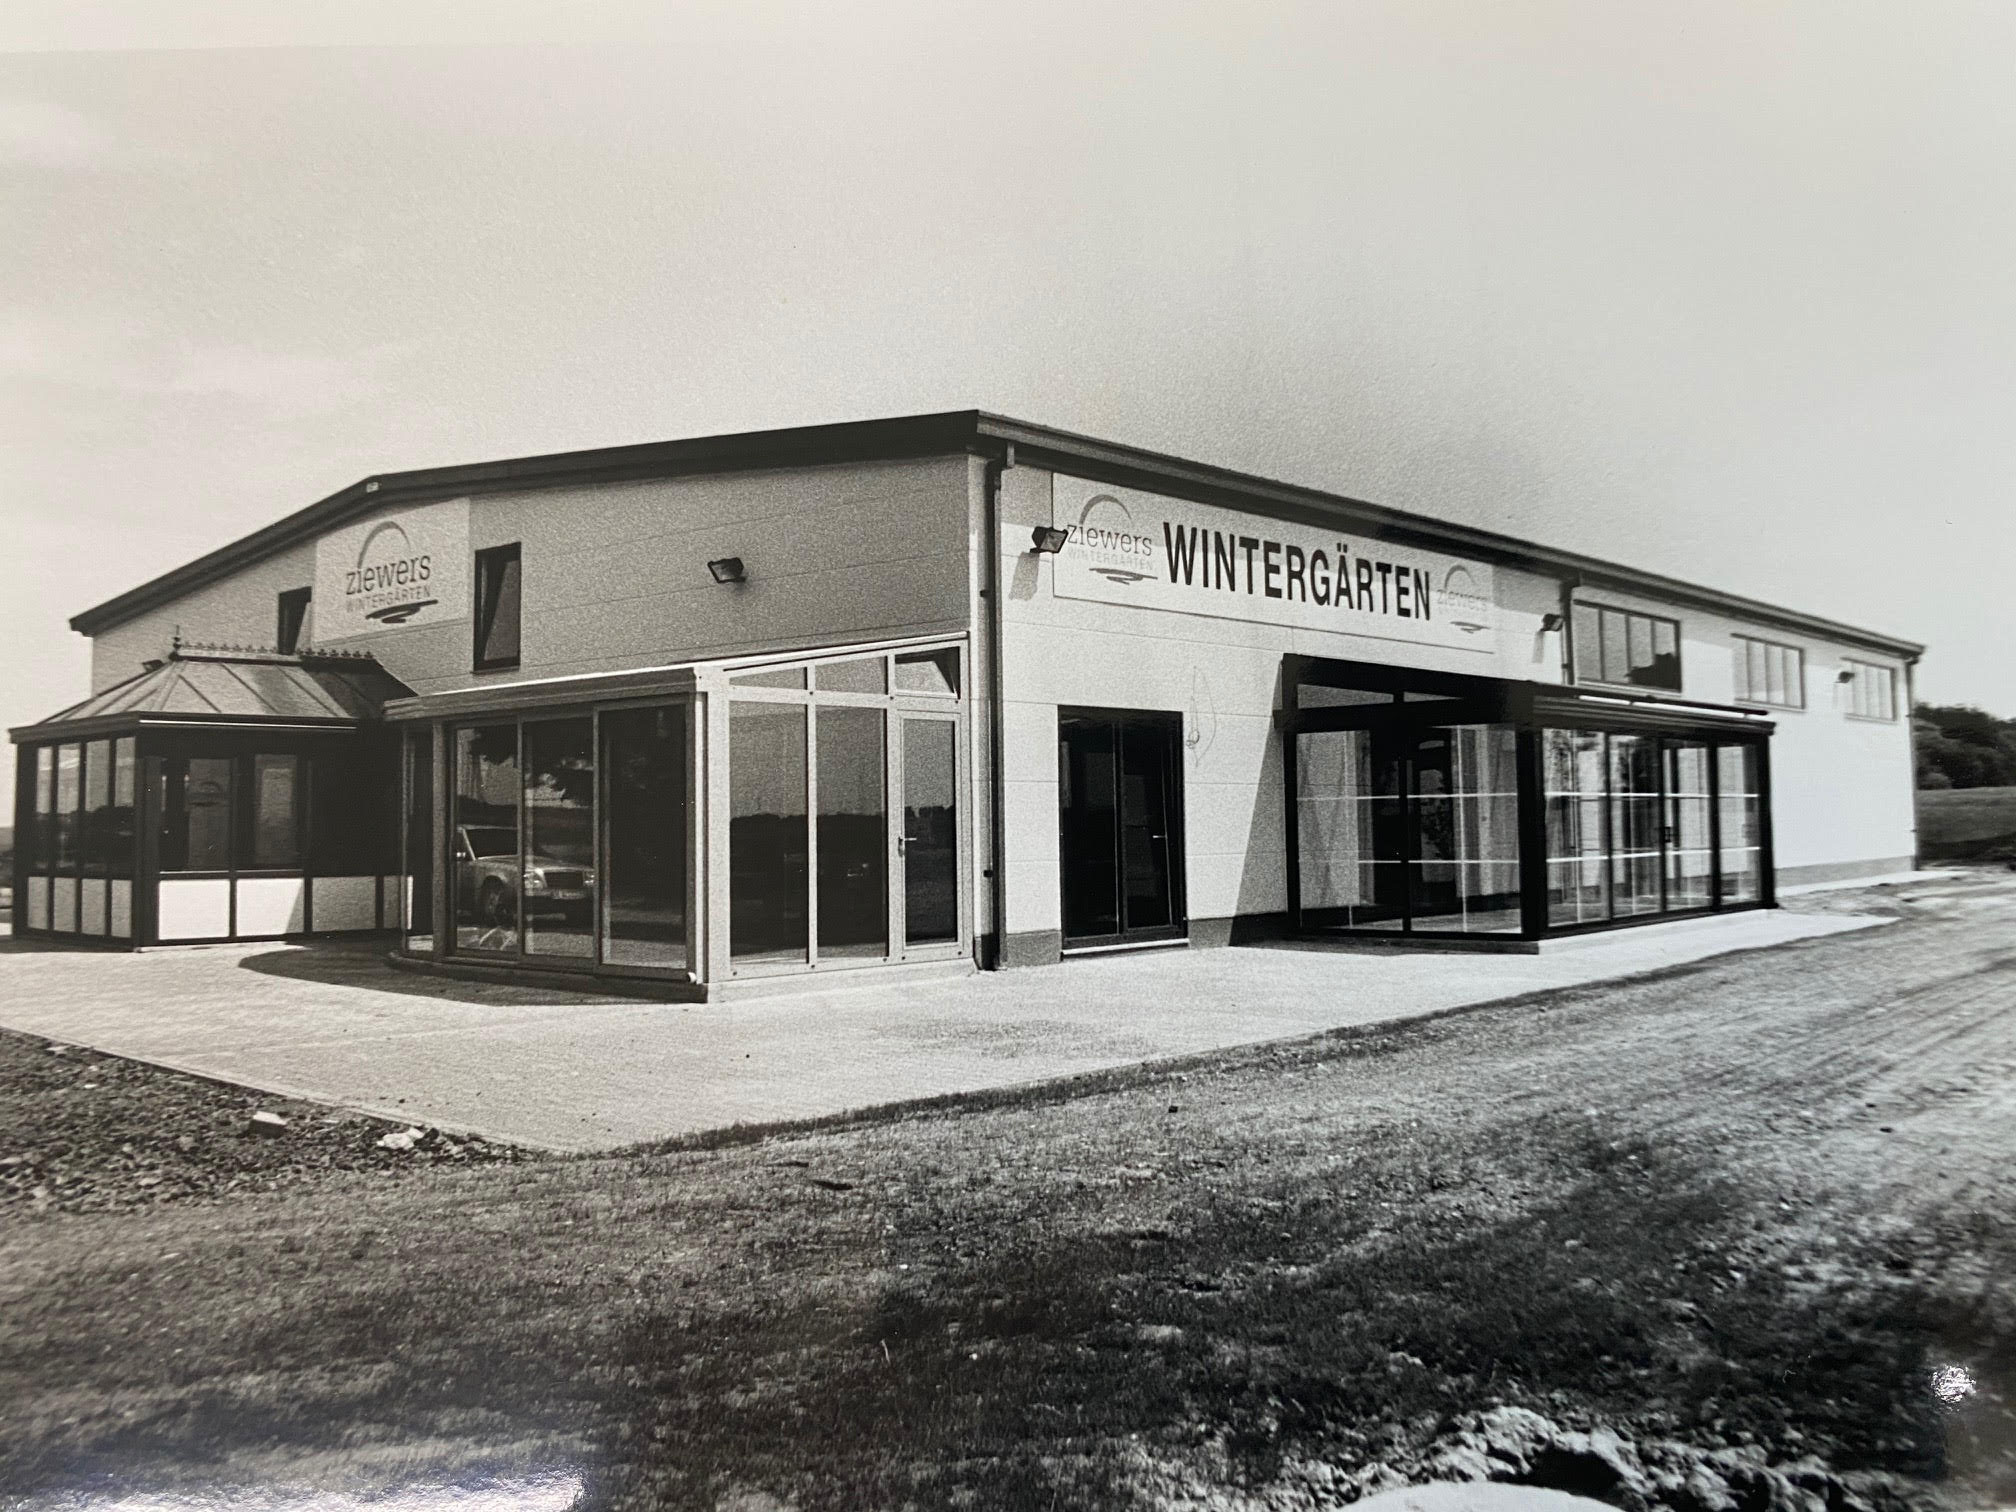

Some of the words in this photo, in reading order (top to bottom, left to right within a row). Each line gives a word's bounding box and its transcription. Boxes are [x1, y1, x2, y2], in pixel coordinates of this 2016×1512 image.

[1067, 524, 1152, 556] ziewers
[345, 555, 431, 595] ziewers
[1163, 521, 1430, 621] WINTERGÄRTEN
